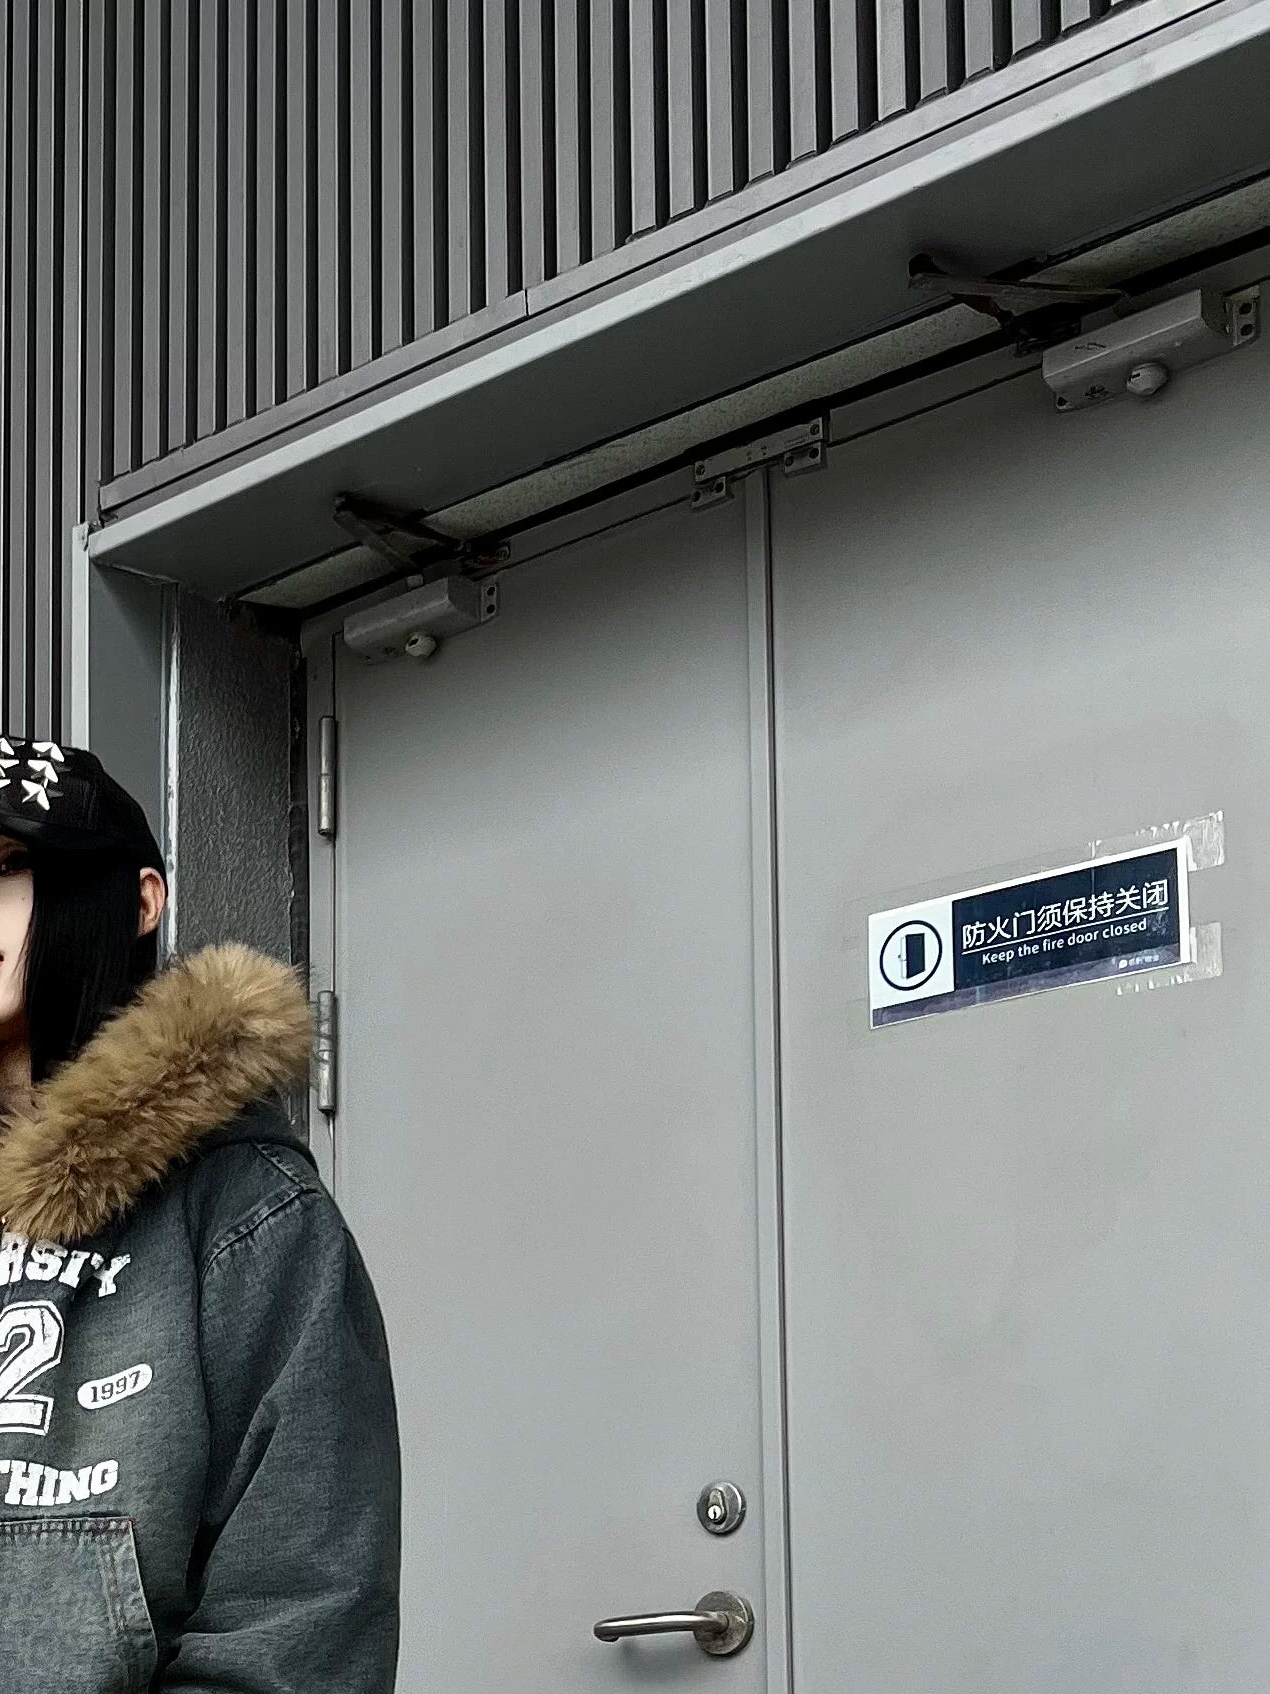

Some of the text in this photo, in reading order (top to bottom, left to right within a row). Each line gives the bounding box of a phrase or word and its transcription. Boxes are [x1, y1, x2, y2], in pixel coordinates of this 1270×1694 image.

[962, 879, 1169, 949] 防火门须保持关闭
[982, 918, 1147, 965] Keep the fire door closed
[91, 1370, 140, 1402] 1997
